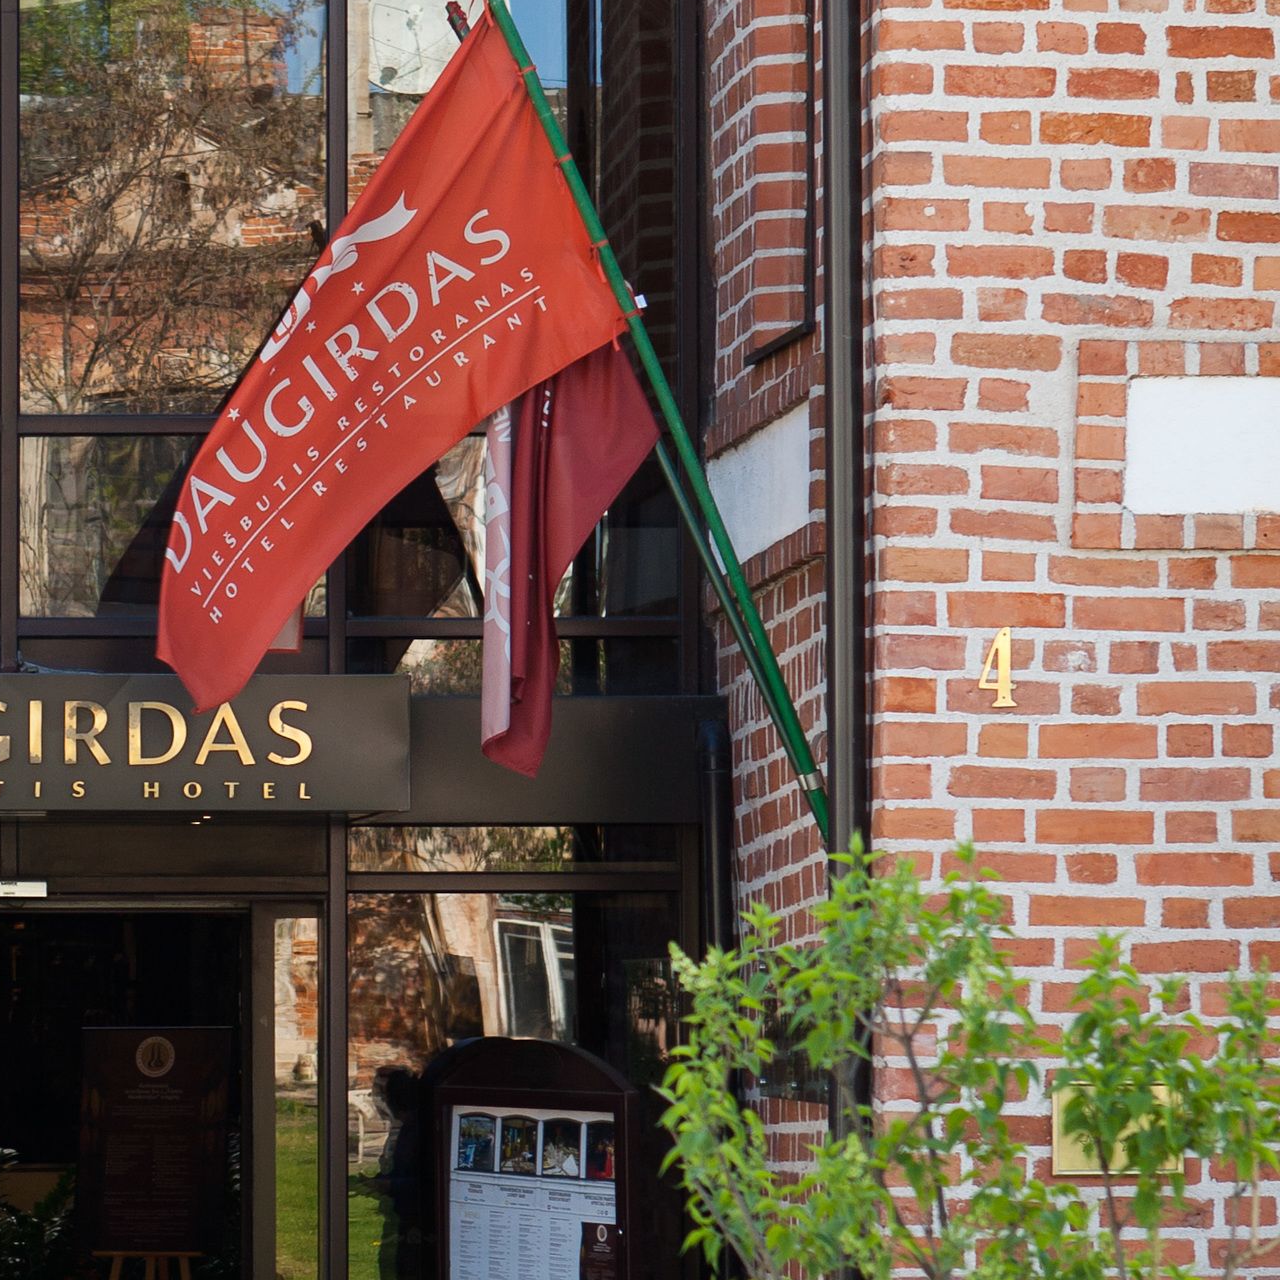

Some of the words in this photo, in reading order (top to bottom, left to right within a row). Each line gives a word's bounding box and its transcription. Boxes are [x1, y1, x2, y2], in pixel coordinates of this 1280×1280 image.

[165, 208, 511, 574] DAUGIRDAS
[190, 446, 320, 596] VIEŠBUTIS
[337, 267, 534, 431] RESTORANAS
[209, 517, 295, 624] HOTEL
[311, 296, 547, 497] RESTAURANT
[143, 781, 312, 799] HOTEL
[978, 626, 1018, 708] 4
